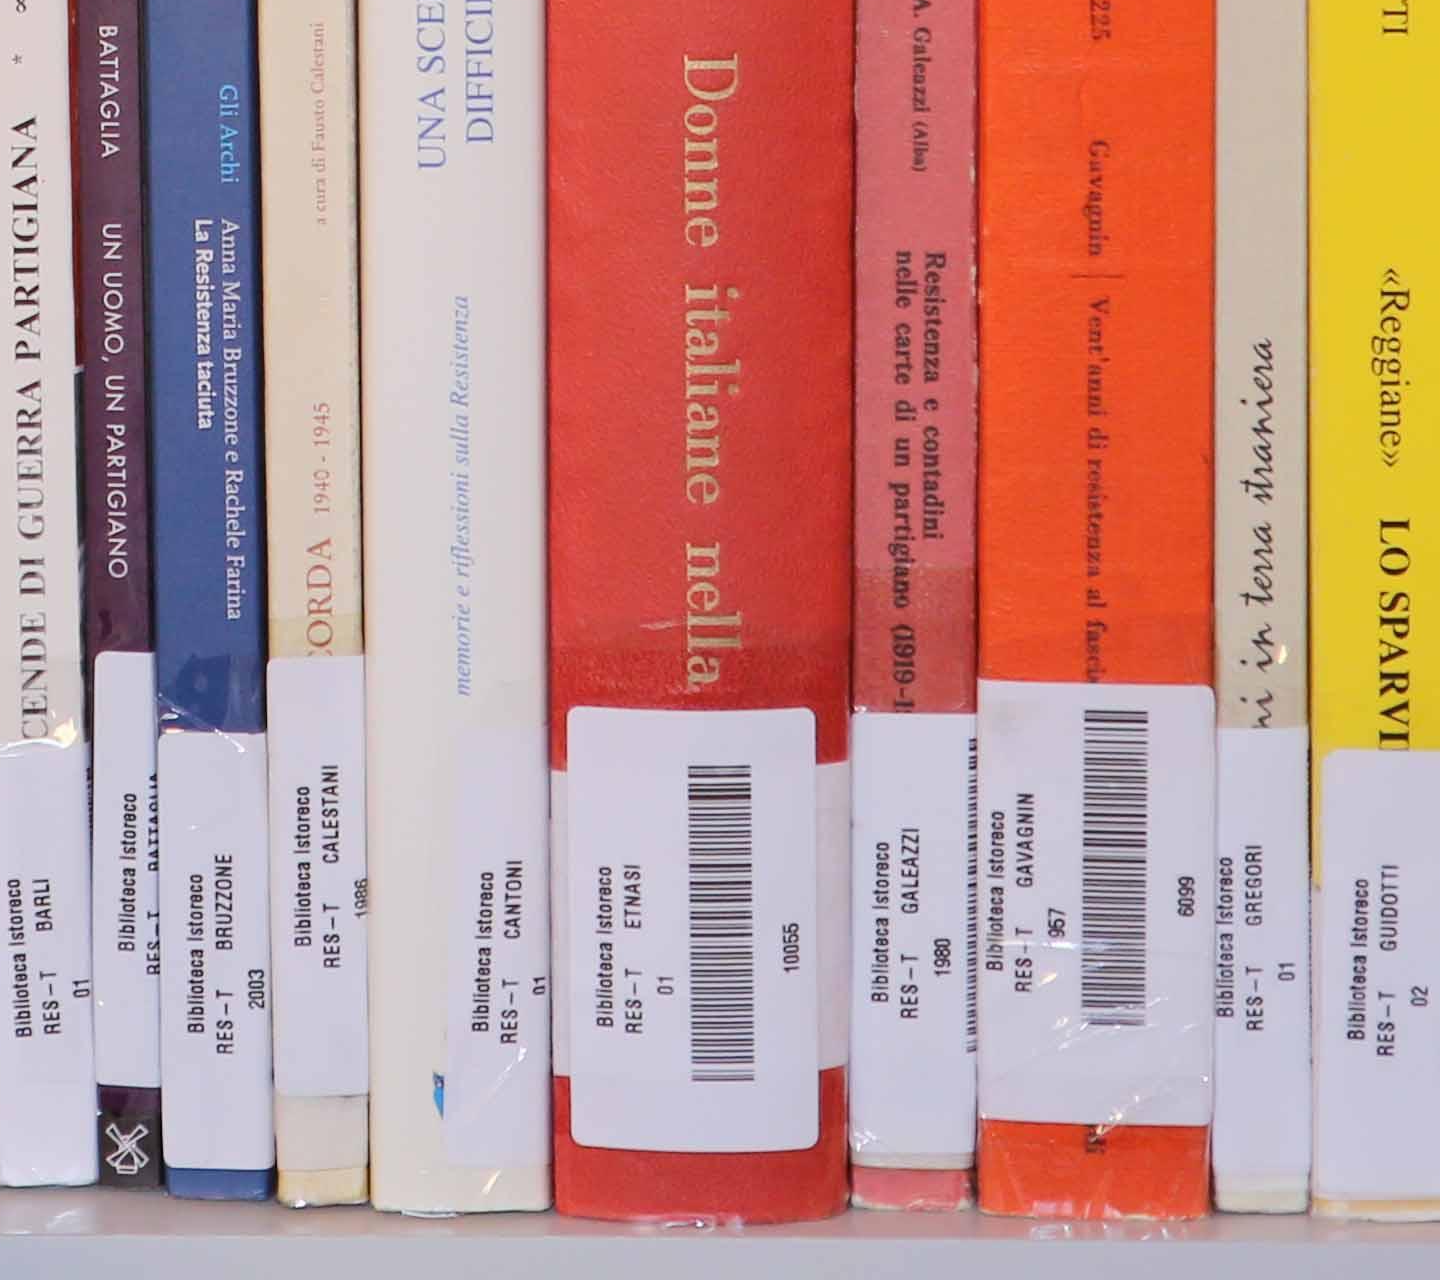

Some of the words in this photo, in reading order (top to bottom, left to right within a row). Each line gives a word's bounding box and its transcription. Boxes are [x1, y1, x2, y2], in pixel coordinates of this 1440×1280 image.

[99, 25, 120, 158] BATTAGLIA
[417, 87, 448, 170] UNA
[680, 54, 741, 246] Donne
[9, 116, 45, 361] PARTIGIANA
[103, 222, 124, 261] UN
[195, 218, 213, 243] La
[222, 218, 241, 275] Anna
[102, 271, 125, 366] UOMO,
[194, 248, 214, 355] Resistenza
[222, 280, 242, 341] Maria
[105, 374, 126, 413] UN
[195, 360, 216, 430] taciuta
[224, 346, 243, 445] Bruzzone
[682, 282, 742, 505] italiane
[15, 378, 47, 539] GUERRA
[106, 424, 129, 579] PARTIGIANO
[224, 468, 245, 547] Rachele
[226, 554, 247, 620] Farina
[1377, 518, 1409, 580] LO
[685, 541, 745, 690] nella
[214, 854, 233, 951] BRUZZONE
[625, 863, 642, 929] ETNASI
[901, 827, 919, 915] GALEAZZI
[1178, 876, 1195, 918] 6099
[1380, 863, 1400, 951] GUIDOTTI
[783, 922, 800, 974] 10055
